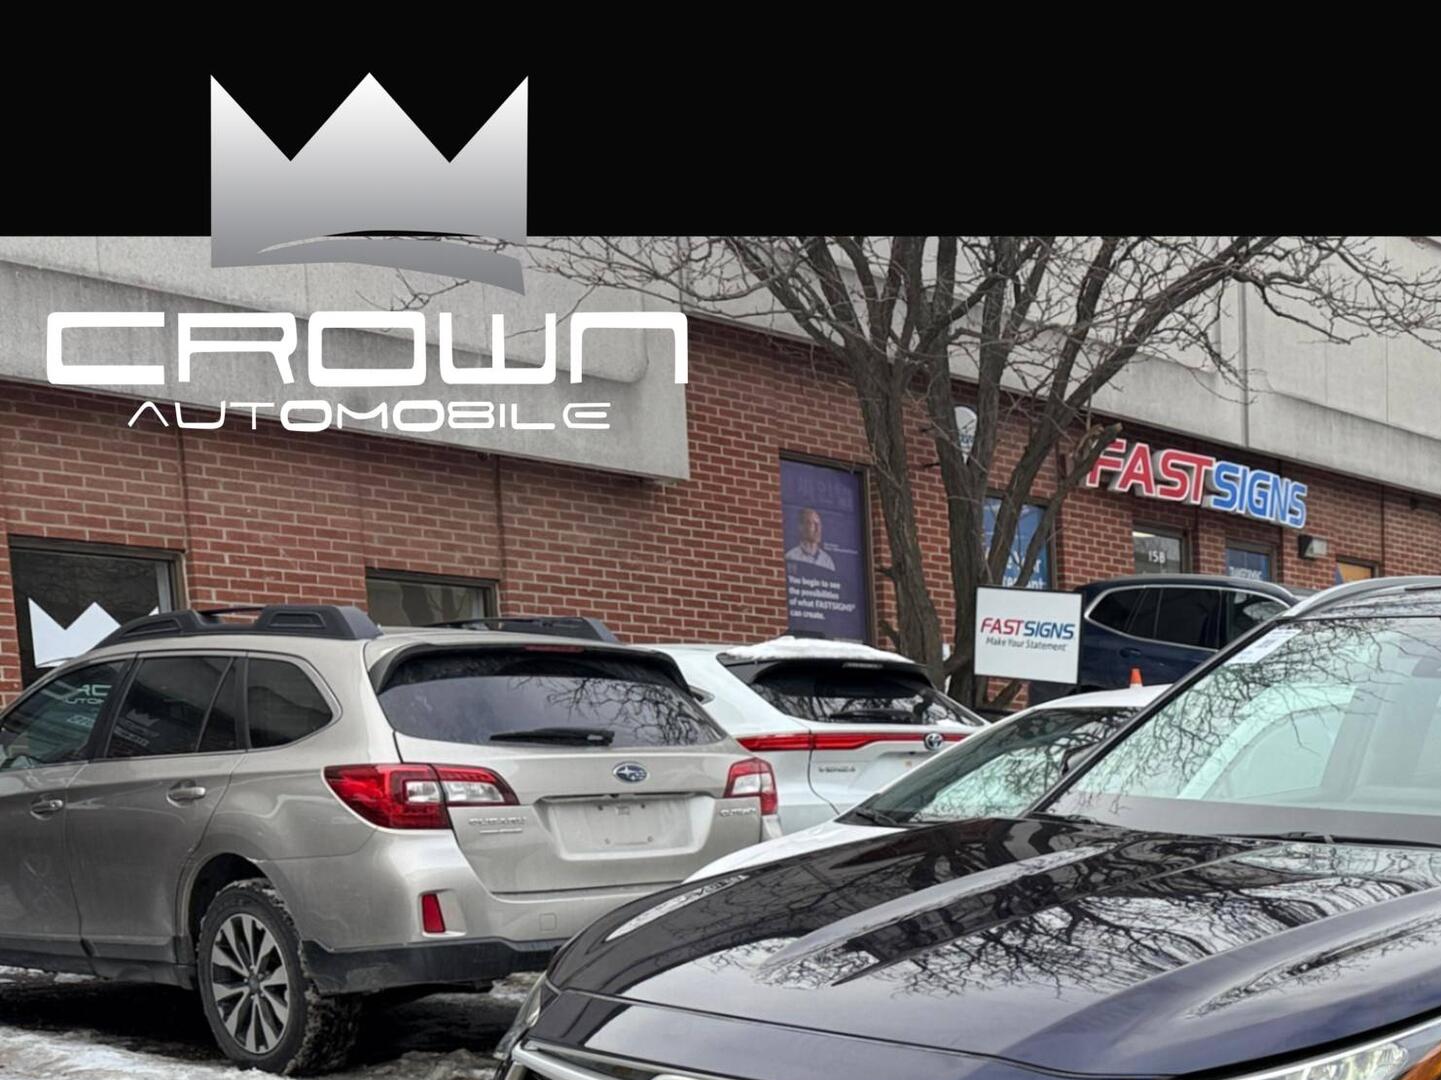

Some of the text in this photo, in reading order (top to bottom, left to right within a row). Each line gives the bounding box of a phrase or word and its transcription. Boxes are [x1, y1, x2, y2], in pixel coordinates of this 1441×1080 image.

[1085, 437, 1308, 530] FASTSIGNS
[980, 617, 1075, 640] FASTSIGNS
[986, 636, 1006, 647] Make
[1008, 638, 1024, 648] Your
